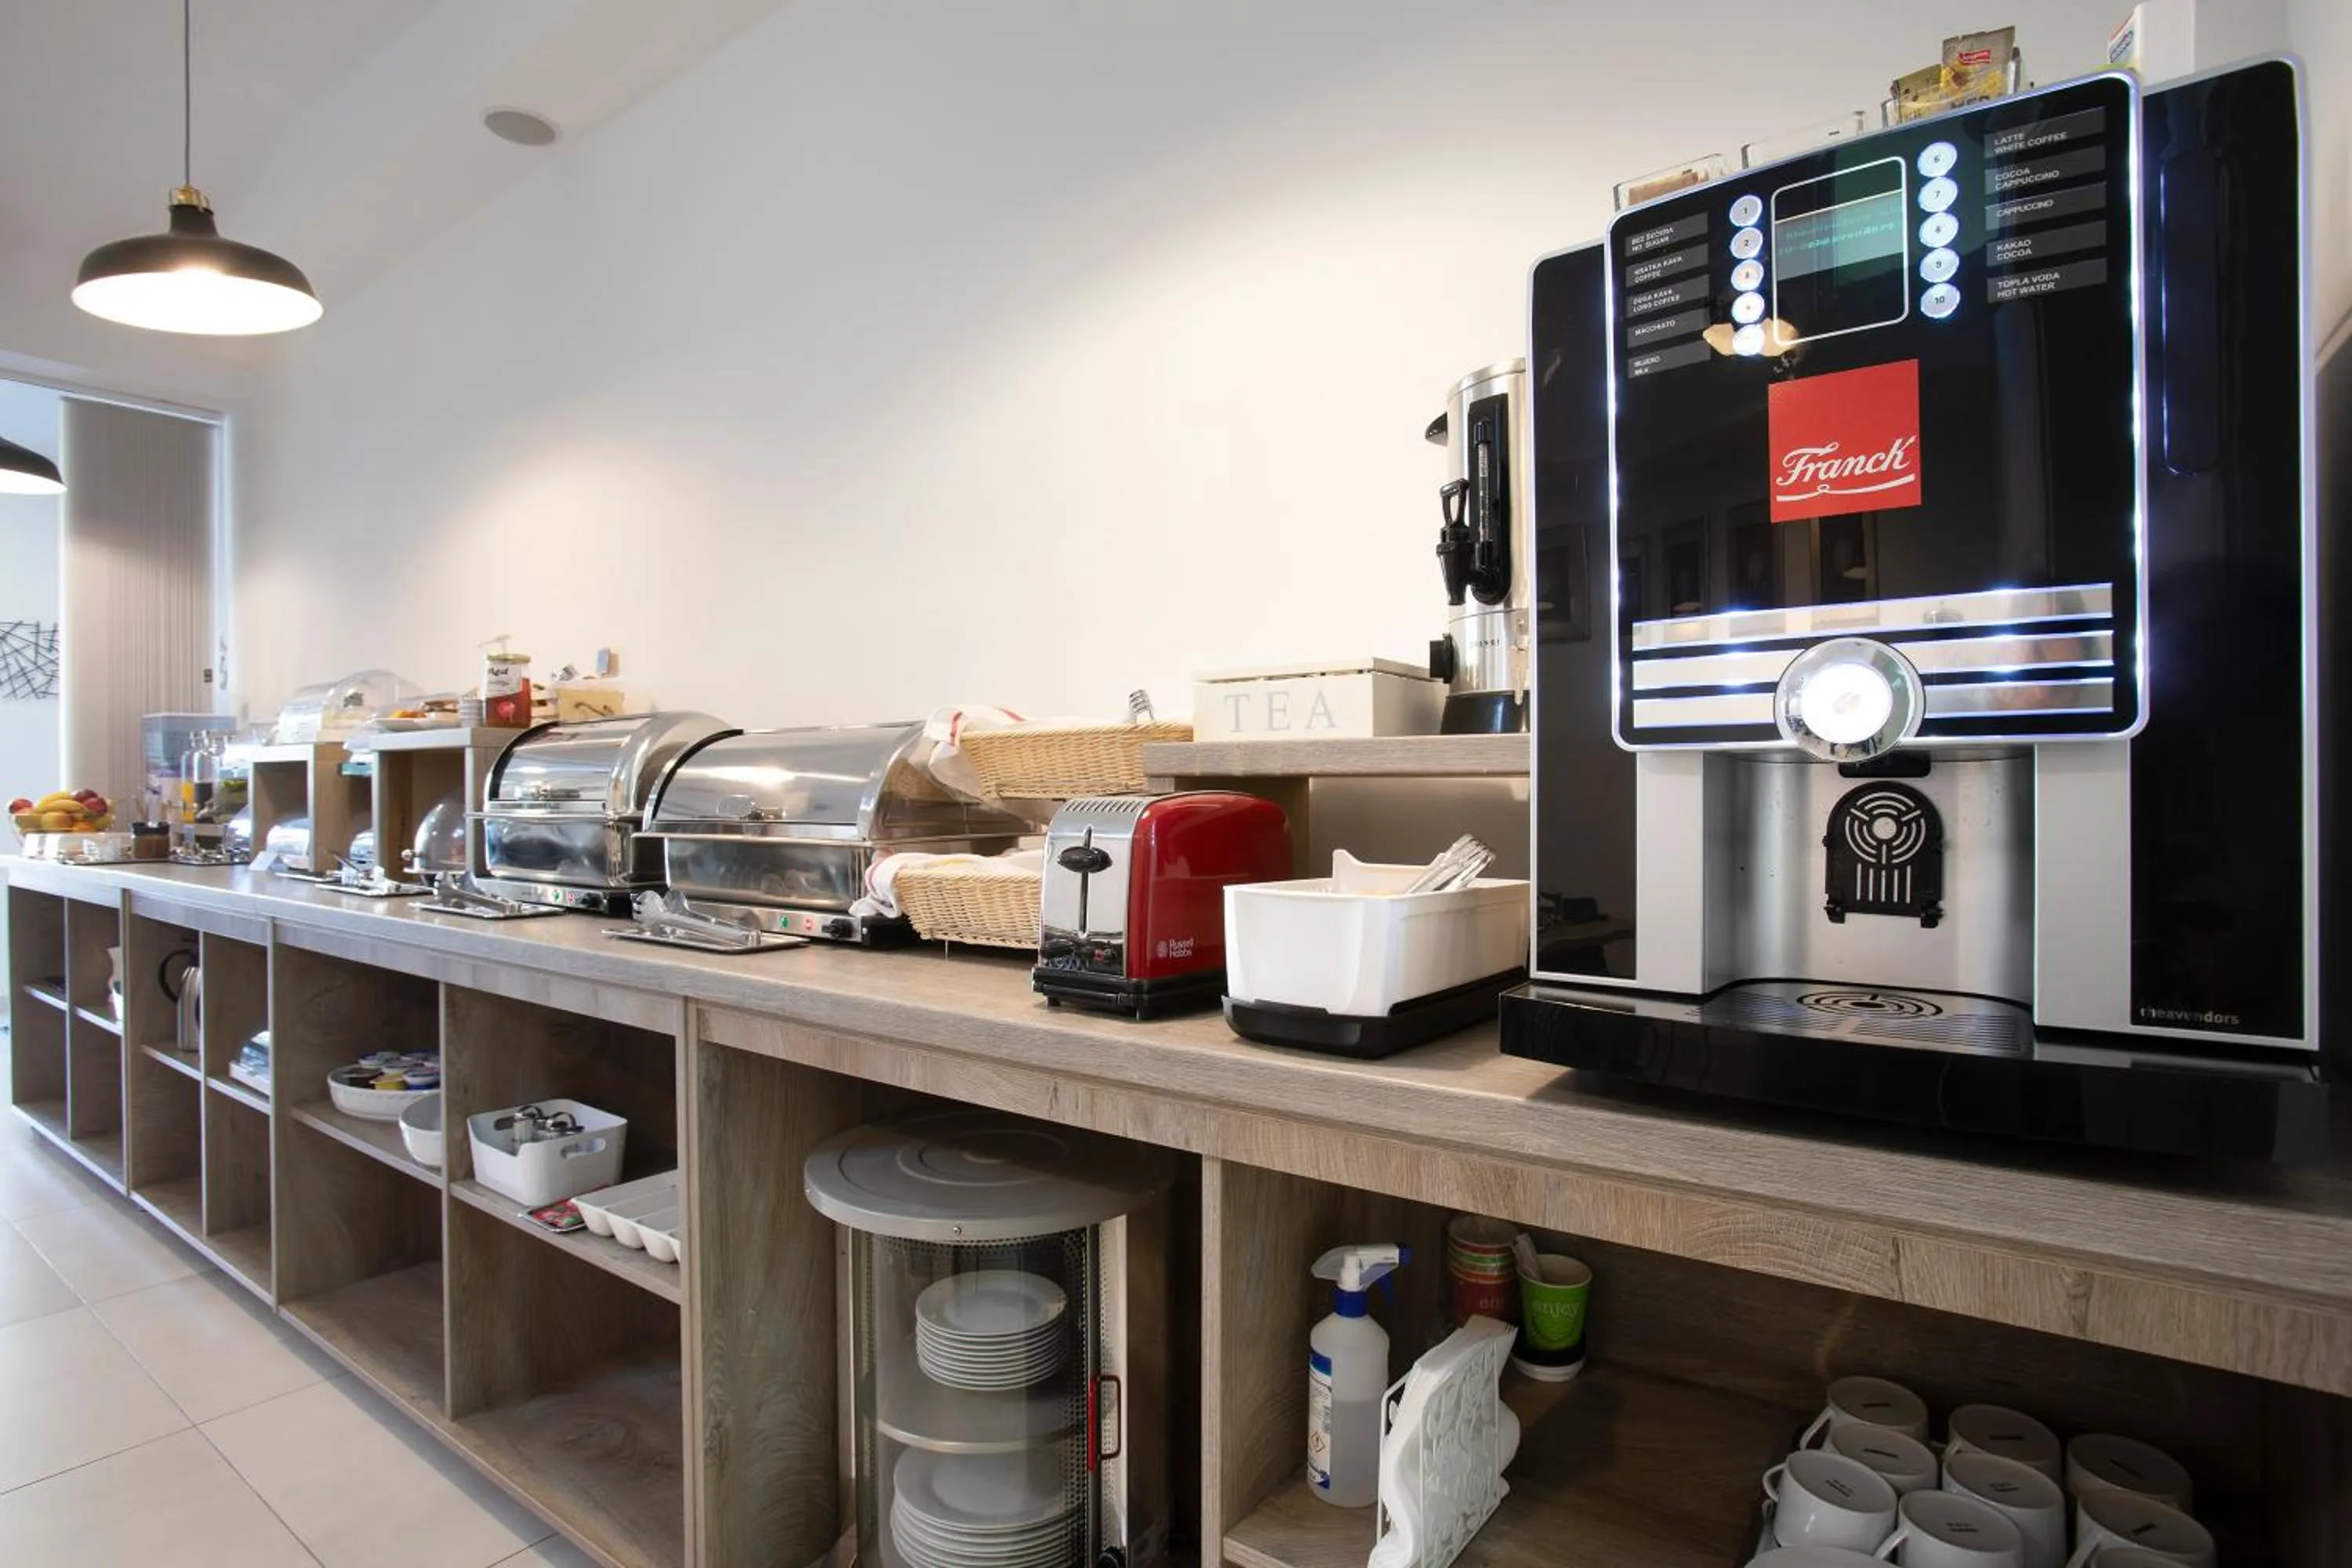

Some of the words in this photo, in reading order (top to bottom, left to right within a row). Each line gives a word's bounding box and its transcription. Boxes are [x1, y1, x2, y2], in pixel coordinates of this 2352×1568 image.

[1994, 132, 2025, 146] LATTE
[1994, 140, 2025, 154] WHITE
[2028, 131, 2067, 147] COFFEE
[1994, 167, 2031, 181] COCOA
[1995, 170, 2060, 191] CAPPUCCINO
[1995, 199, 2054, 217] CAPPUCCINO
[1996, 248, 2032, 260] COCOA
[1997, 239, 2031, 252] KAKAO
[1634, 270, 1661, 283] COFFEE
[1998, 277, 2029, 290] TOPLA
[2032, 271, 2060, 284] VODA
[1997, 287, 2017, 299] HOT
[2020, 282, 2056, 296] WATER
[1653, 294, 1680, 307] COFFEE
[1934, 295, 1945, 305] 10
[1635, 319, 1675, 336] MACCHIATO
[1775, 435, 1917, 486] Franck
[1223, 688, 1339, 734] TEA
[1531, 1298, 1583, 1318] enjoy
